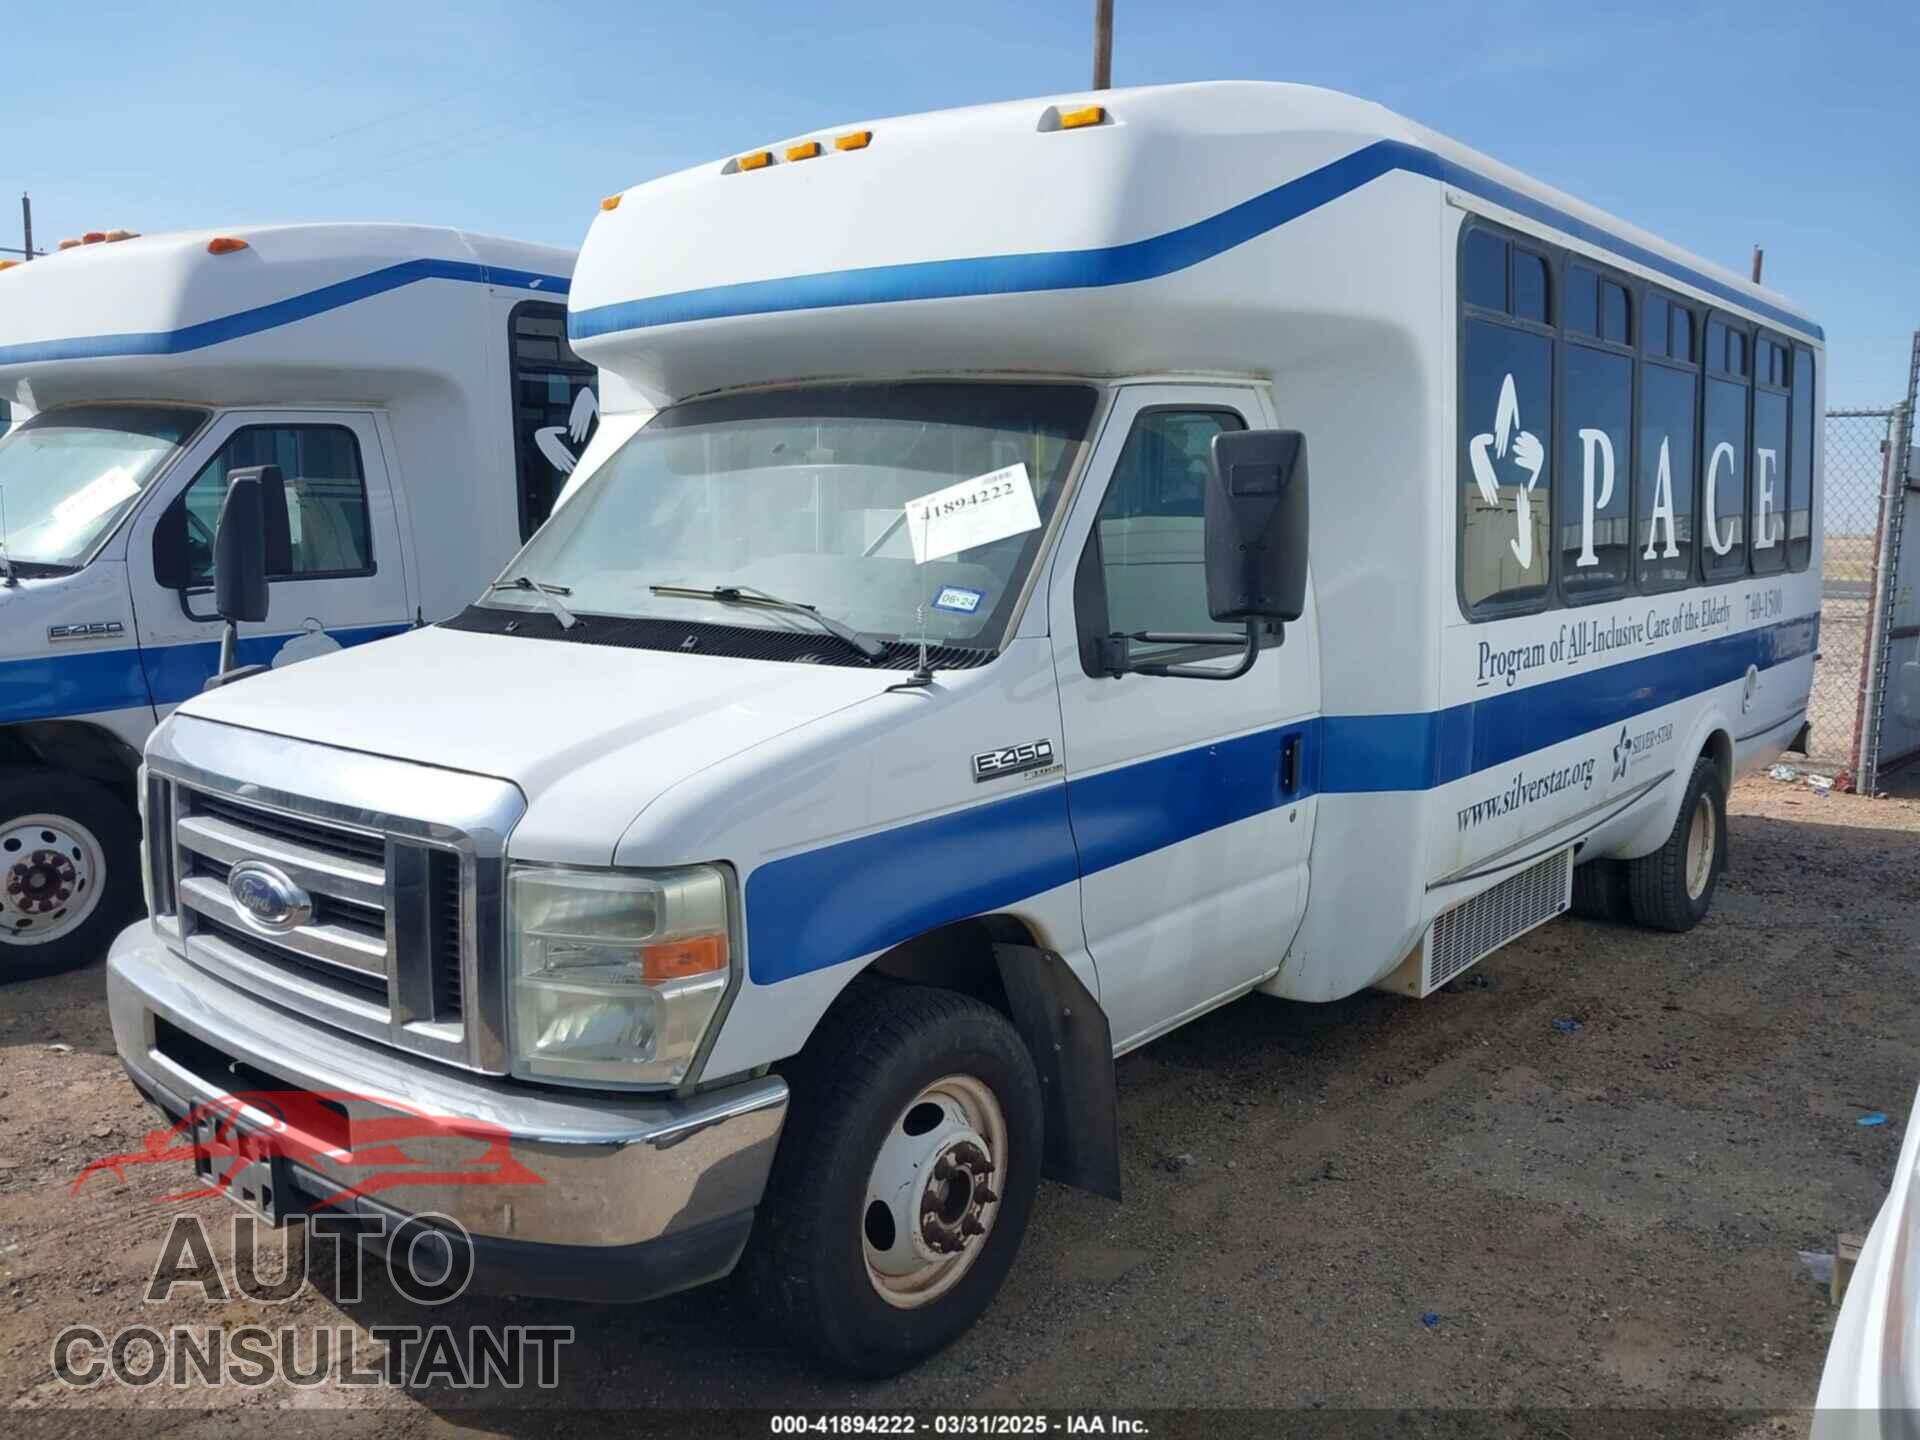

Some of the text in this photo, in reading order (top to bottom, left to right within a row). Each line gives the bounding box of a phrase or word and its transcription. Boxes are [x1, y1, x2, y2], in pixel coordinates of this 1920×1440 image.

[920, 483, 1015, 520] 41894222
[1577, 429, 1778, 567] PACE
[1477, 596, 1732, 686] Program of All-Inclusive Care of the Elderly
[1456, 758, 1595, 832] www.silverstar.org
